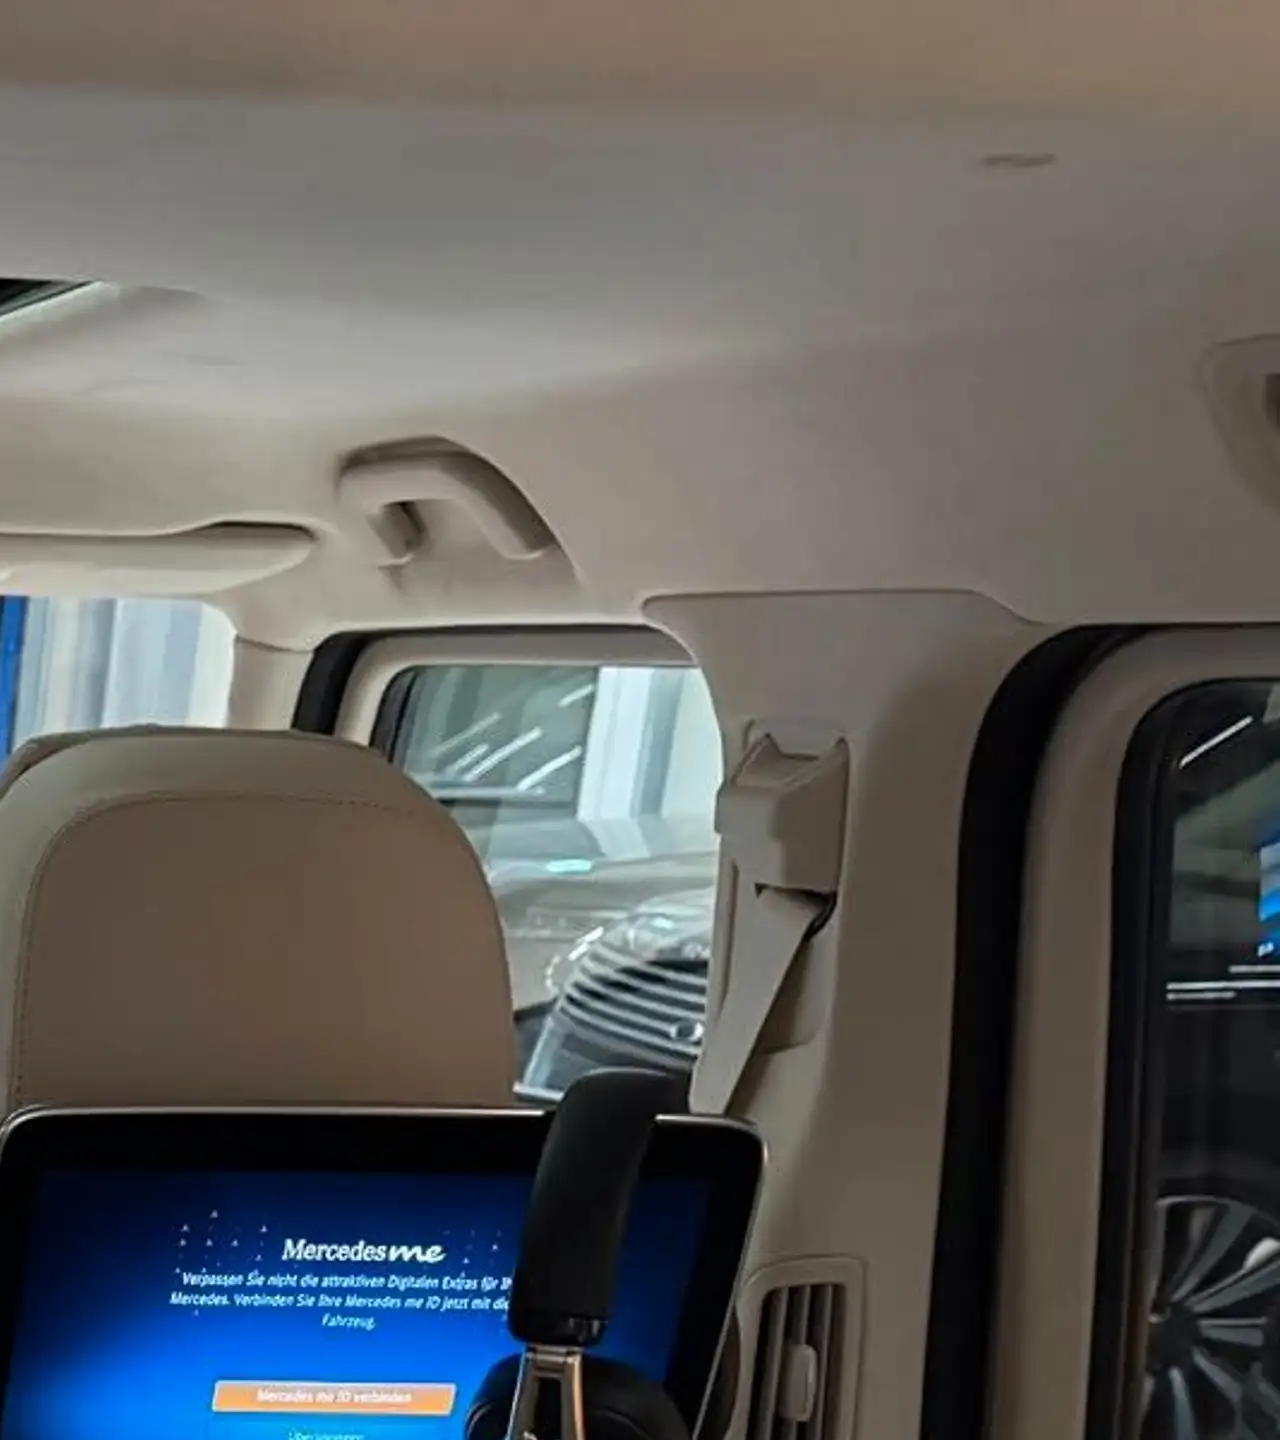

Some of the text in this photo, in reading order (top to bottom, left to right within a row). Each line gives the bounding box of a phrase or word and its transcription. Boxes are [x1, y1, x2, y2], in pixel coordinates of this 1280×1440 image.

[182, 1271, 243, 1287] Verpassen
[246, 1271, 266, 1287] Sie
[267, 1272, 298, 1288] nicht
[300, 1272, 319, 1288] die
[320, 1273, 385, 1288] attraktiven
[387, 1274, 439, 1291] Digitalen
[442, 1275, 479, 1290] Extras
[481, 1276, 499, 1292] für
[169, 1290, 230, 1305] Mercedes.
[234, 1292, 294, 1307] Verbinden
[296, 1293, 315, 1307] Sie
[317, 1294, 342, 1307] Ihre
[344, 1294, 402, 1309] Mercedes
[403, 1297, 424, 1309] me
[425, 1296, 440, 1309] ID
[440, 1296, 470, 1312] jetzt
[470, 1296, 491, 1309] mit
[256, 1388, 412, 1405] Mercedes me ID verbinden
